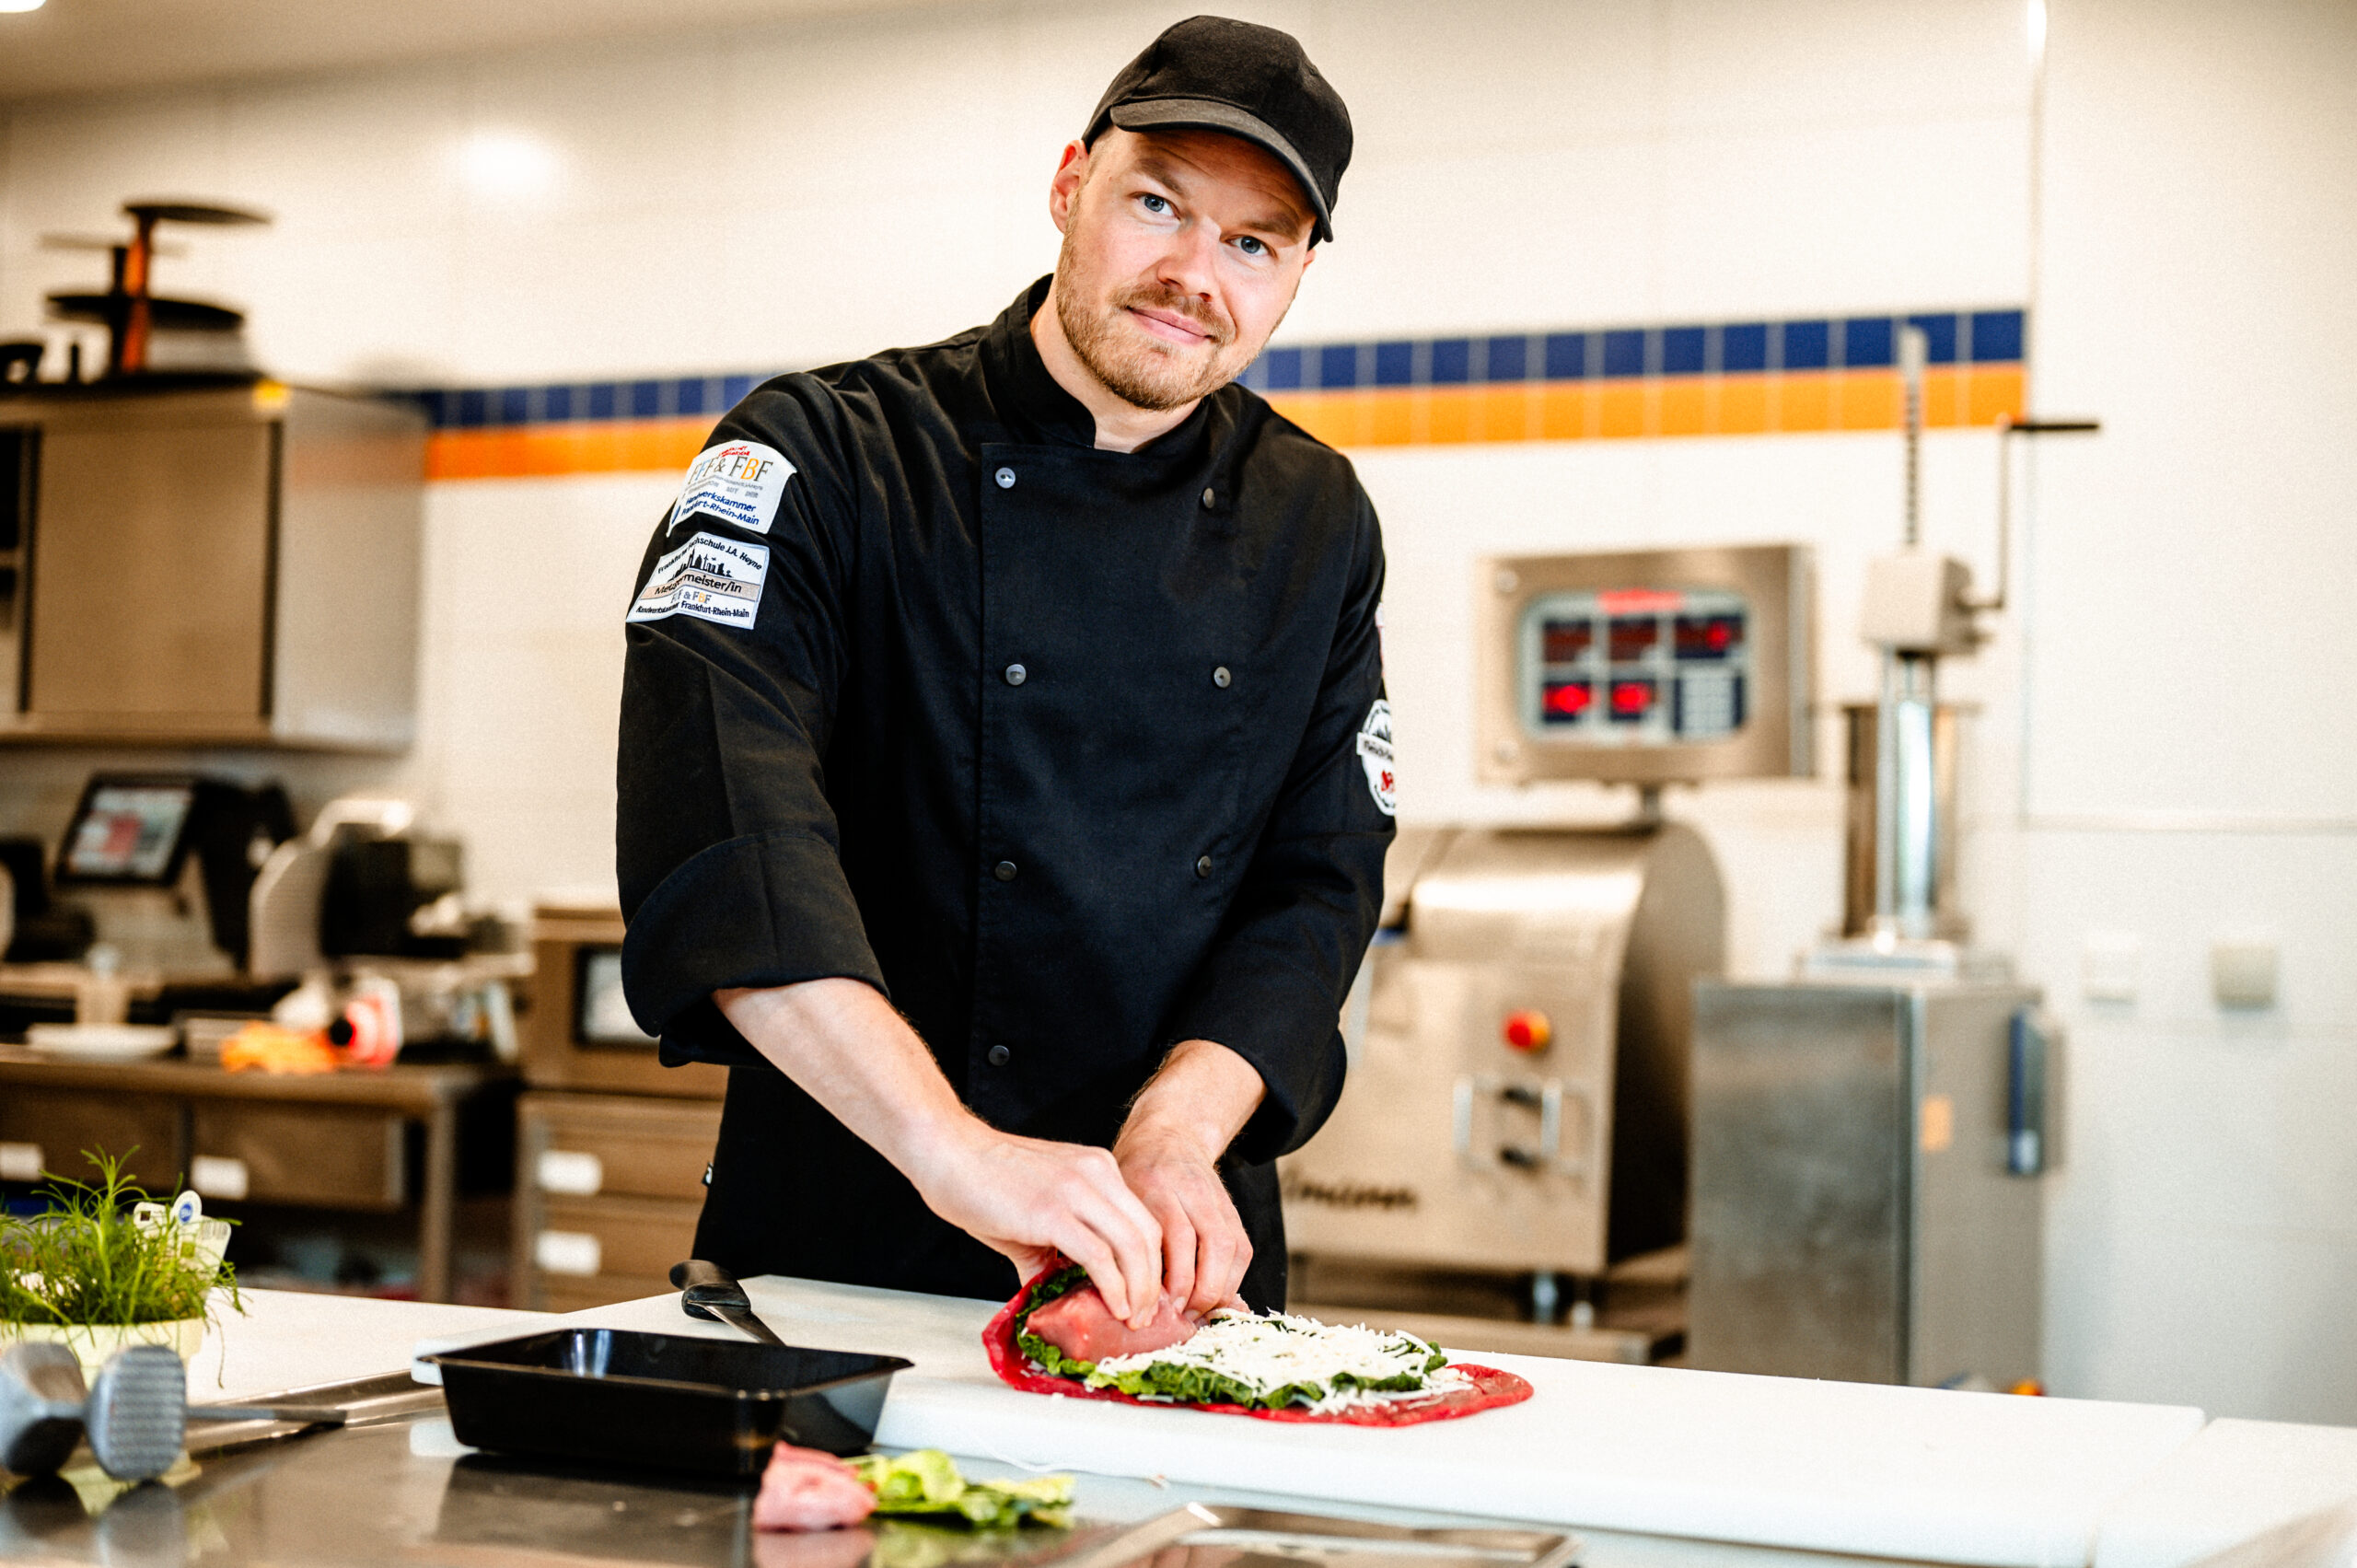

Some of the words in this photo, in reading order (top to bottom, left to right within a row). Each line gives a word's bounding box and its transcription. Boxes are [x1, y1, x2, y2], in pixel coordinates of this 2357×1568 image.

[714, 458, 726, 472] &
[729, 456, 773, 482] FBF
[739, 552, 762, 570] Heyne
[683, 591, 691, 599] &
[691, 590, 713, 604] FBF
[680, 600, 749, 618] Frankfurt-Rhein-Main
